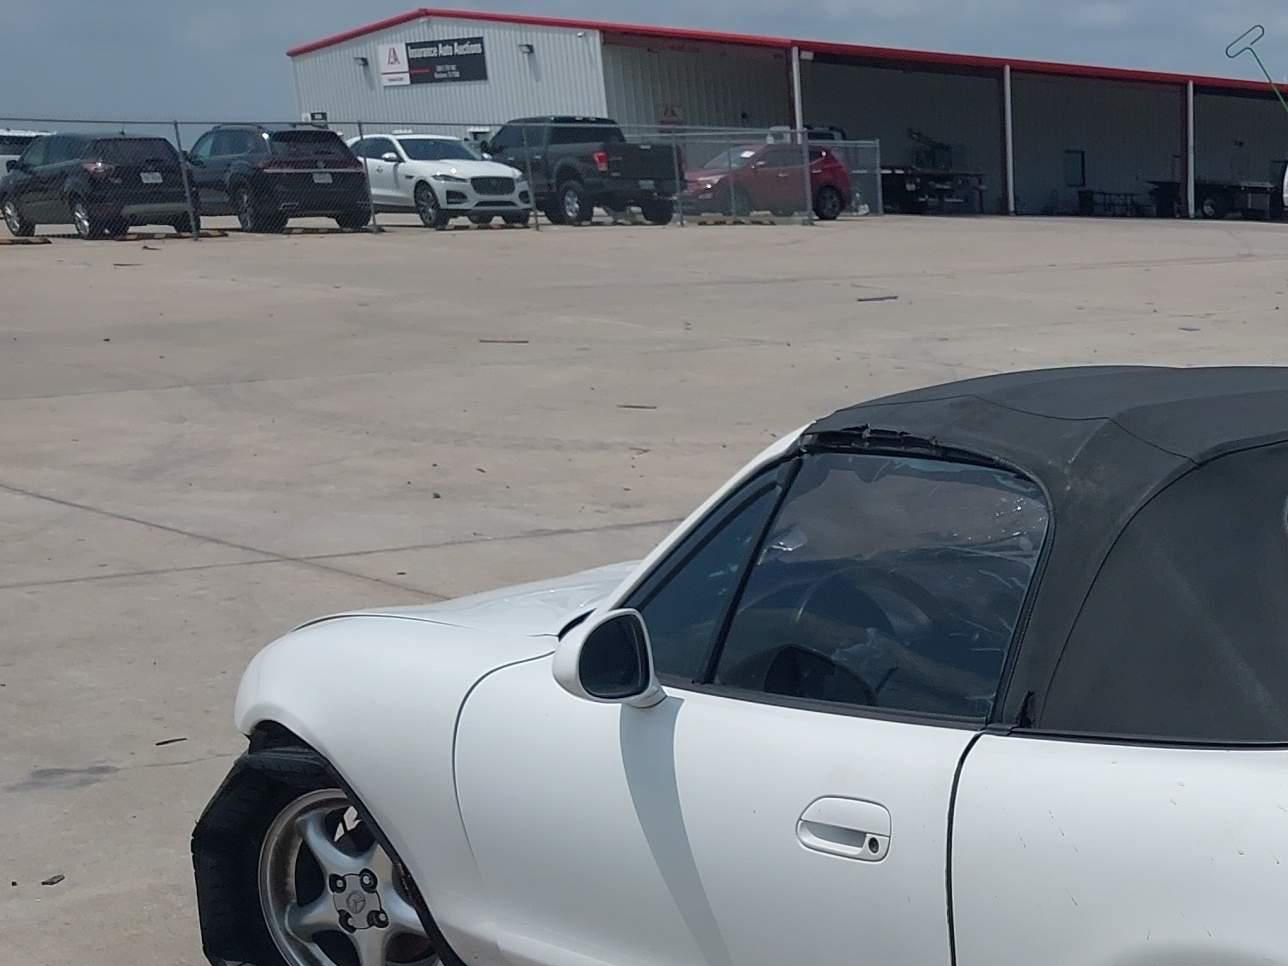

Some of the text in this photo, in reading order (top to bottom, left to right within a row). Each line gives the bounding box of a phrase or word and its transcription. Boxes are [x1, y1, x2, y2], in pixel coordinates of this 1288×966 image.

[408, 41, 482, 58] Insurance Auto Auctions
